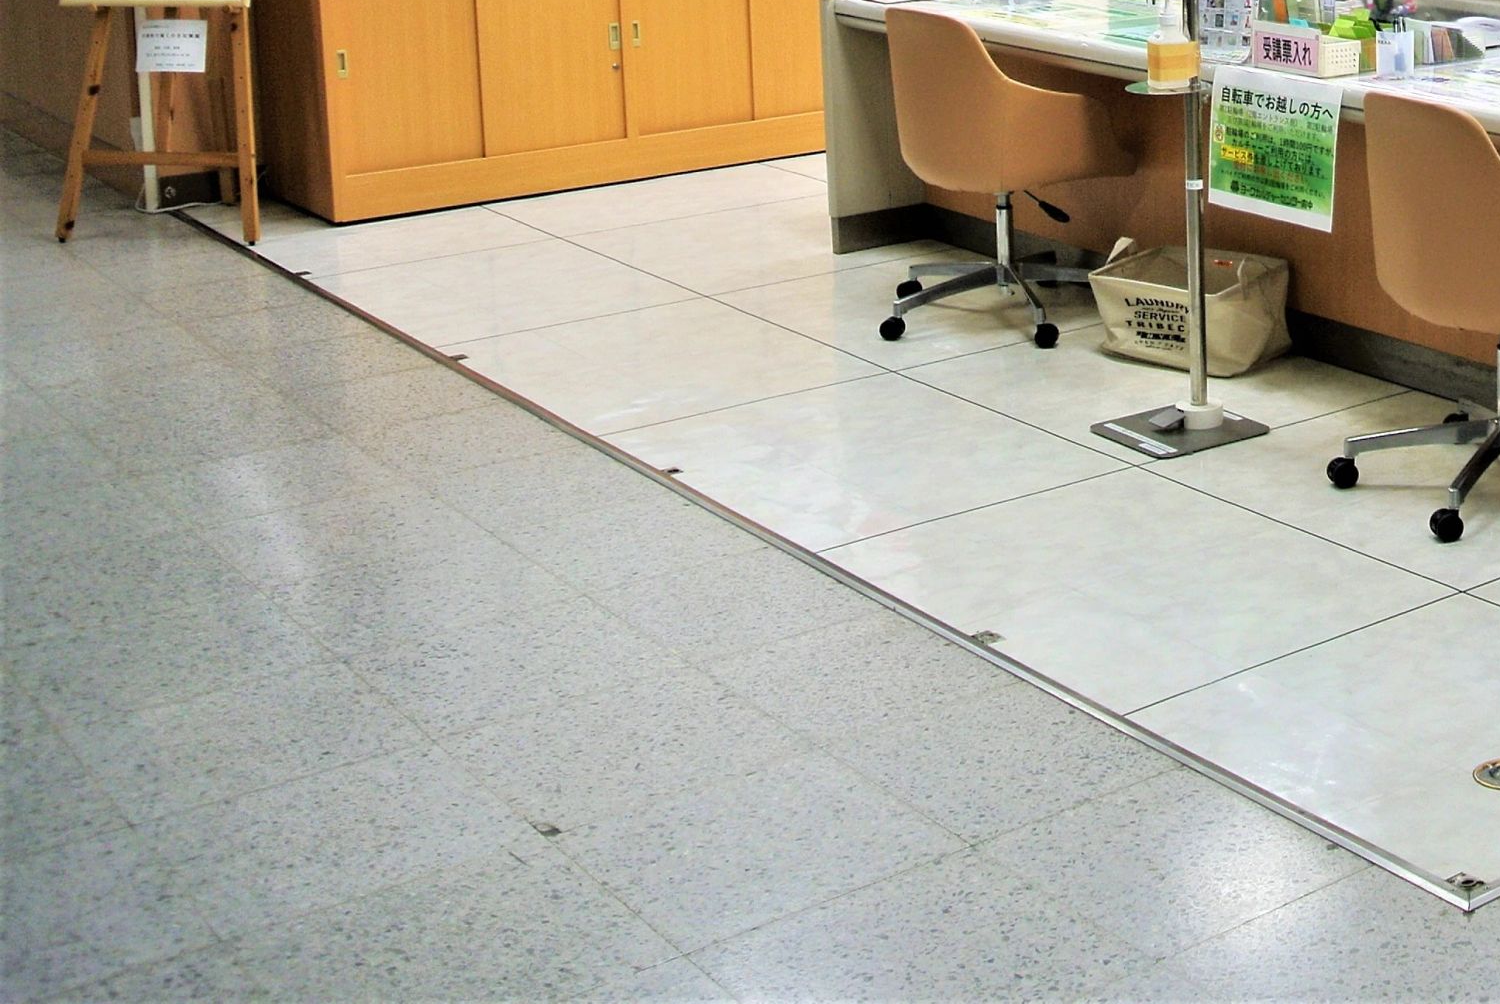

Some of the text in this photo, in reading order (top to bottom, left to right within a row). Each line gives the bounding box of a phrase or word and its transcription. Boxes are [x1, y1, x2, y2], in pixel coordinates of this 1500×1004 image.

[1262, 36, 1312, 66] 受講票入れ
[1221, 87, 1334, 121] 自転車でお越しの方へ
[1125, 319, 1186, 333] TRIBEC
[1134, 310, 1187, 324] SERVICE
